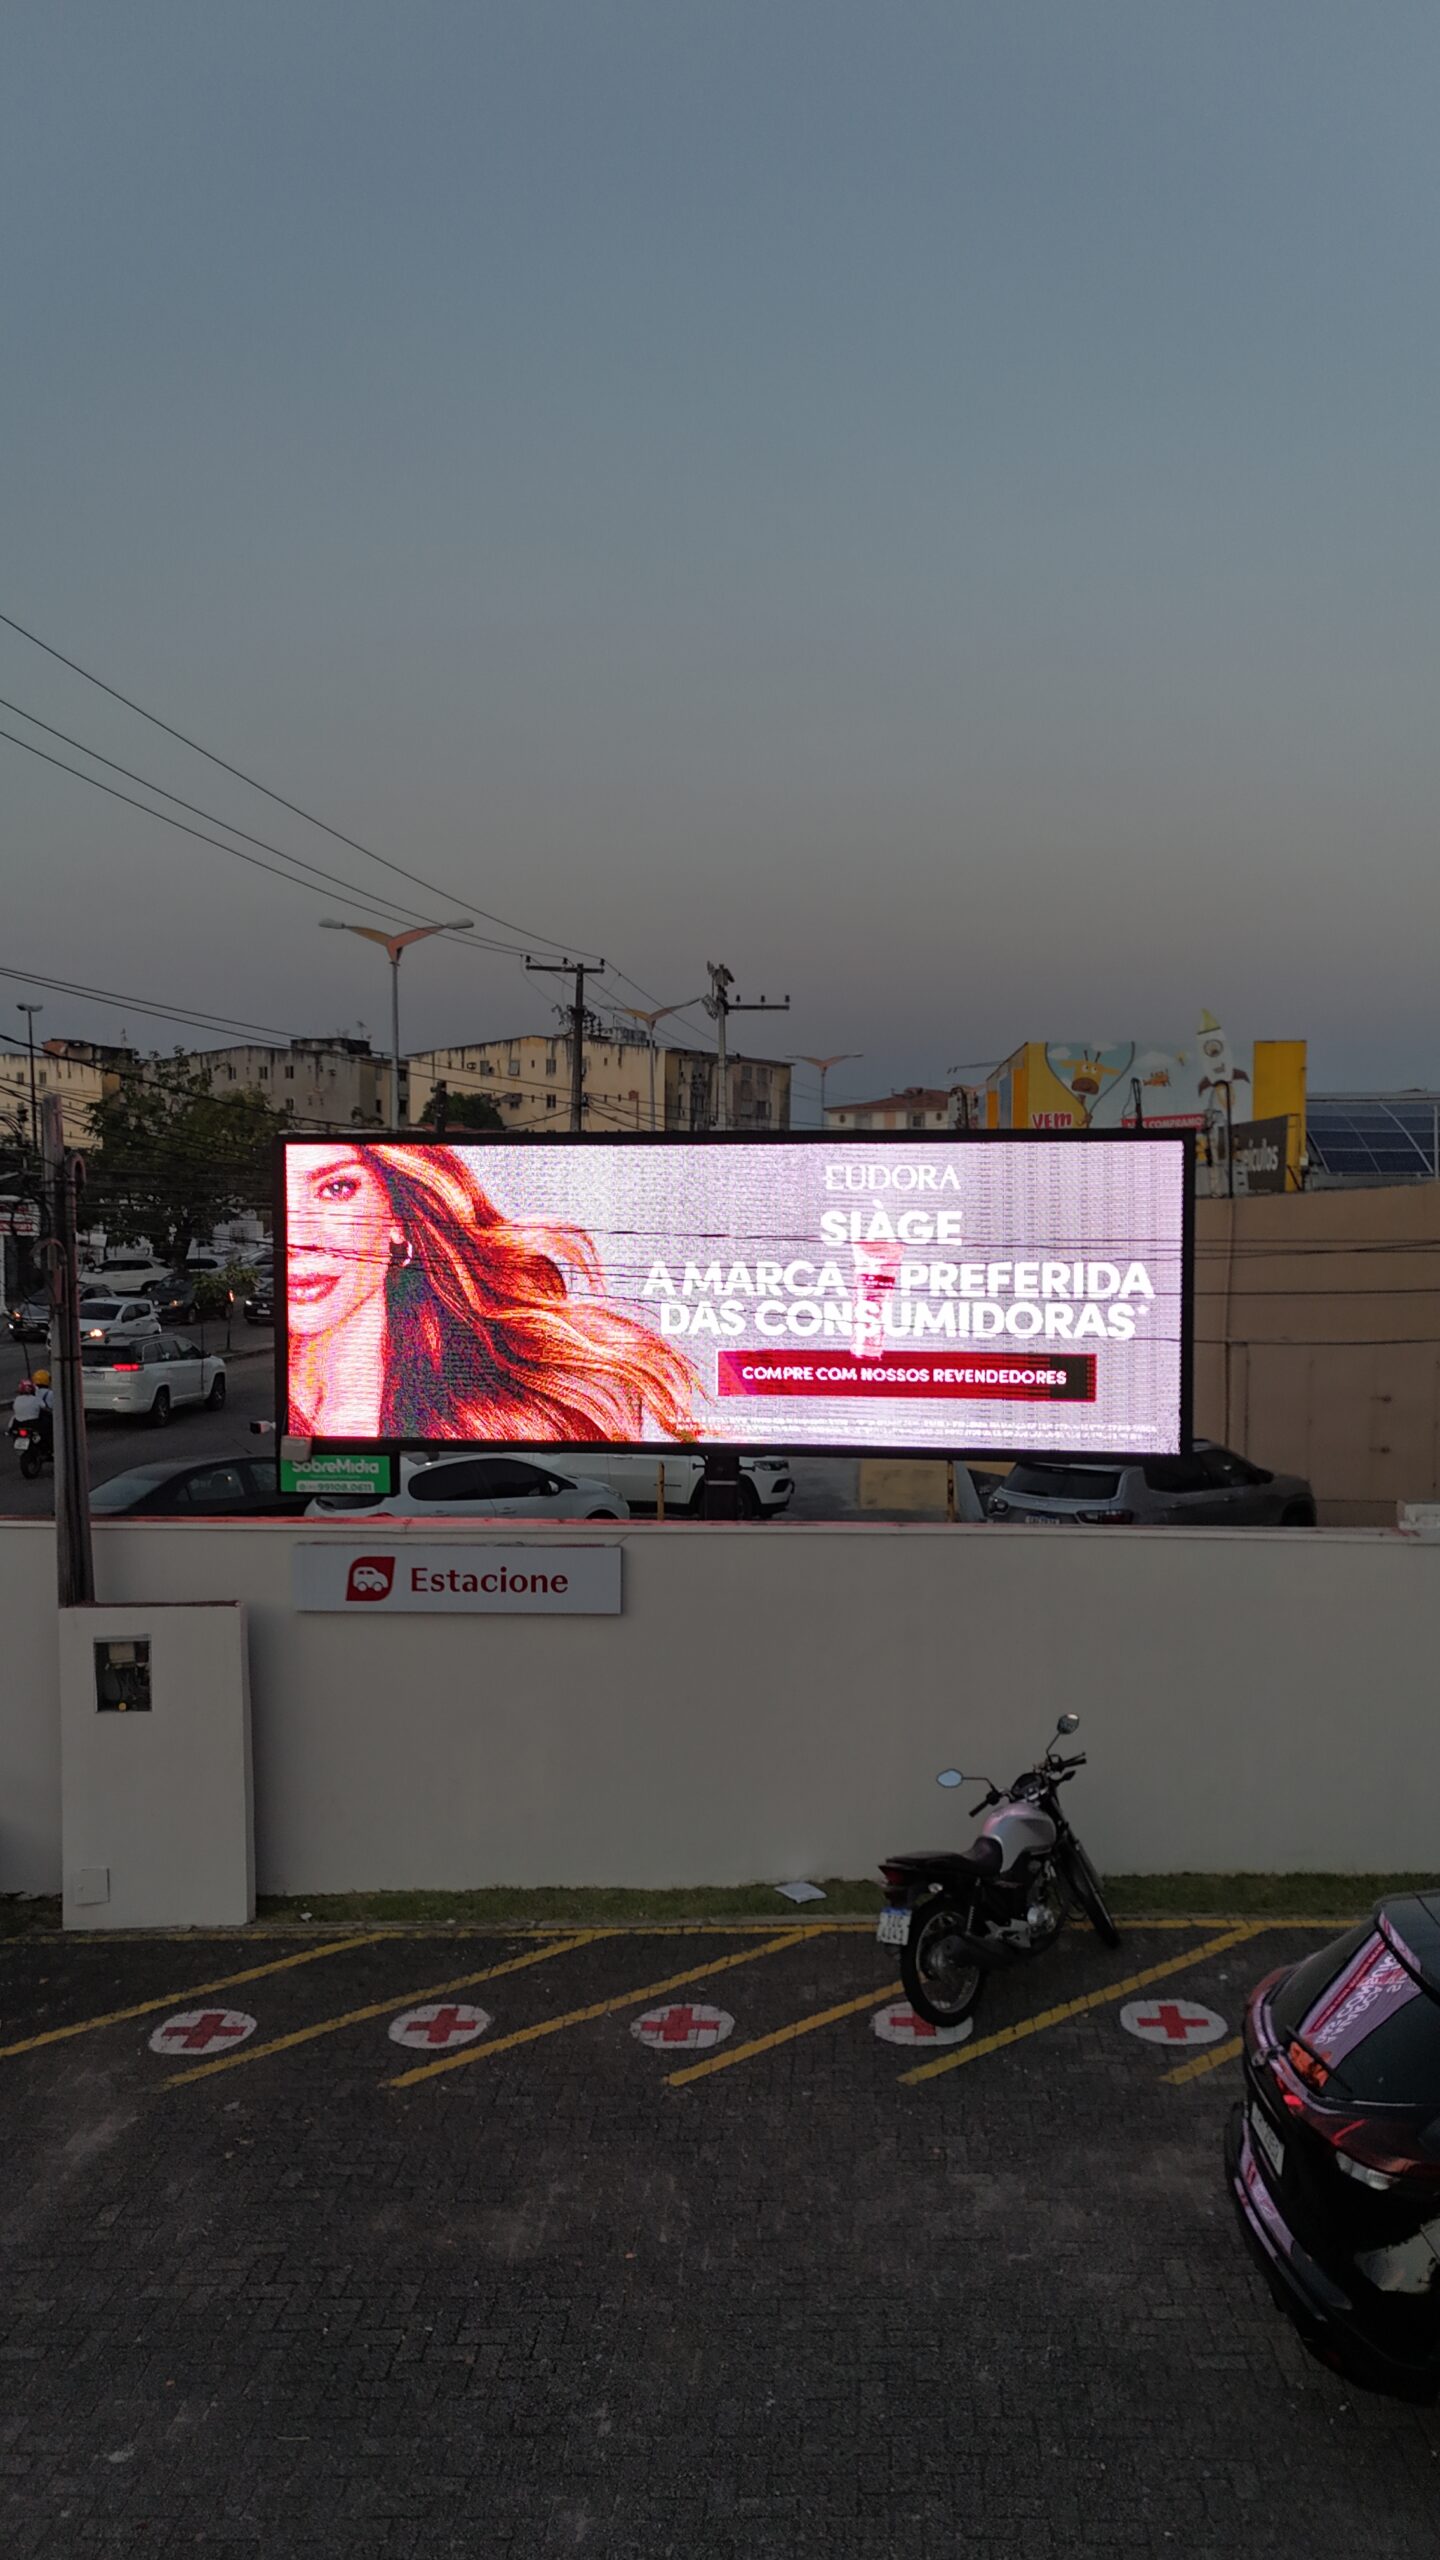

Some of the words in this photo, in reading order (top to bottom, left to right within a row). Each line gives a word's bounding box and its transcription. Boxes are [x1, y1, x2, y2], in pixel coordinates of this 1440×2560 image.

[823, 1164, 961, 1191] EUDORA
[820, 1200, 963, 1246] SIÀGE
[641, 1261, 675, 1296] A
[682, 1261, 848, 1297] MARCA
[899, 1261, 1156, 1298] PREFERIDA
[660, 1300, 747, 1336] DAS
[742, 1365, 814, 1381] COMPRE
[815, 1366, 858, 1381] COM
[860, 1367, 930, 1382] NOSSOS
[932, 1368, 1067, 1385] REVENDEDORES
[411, 1566, 569, 1593] Estacione
